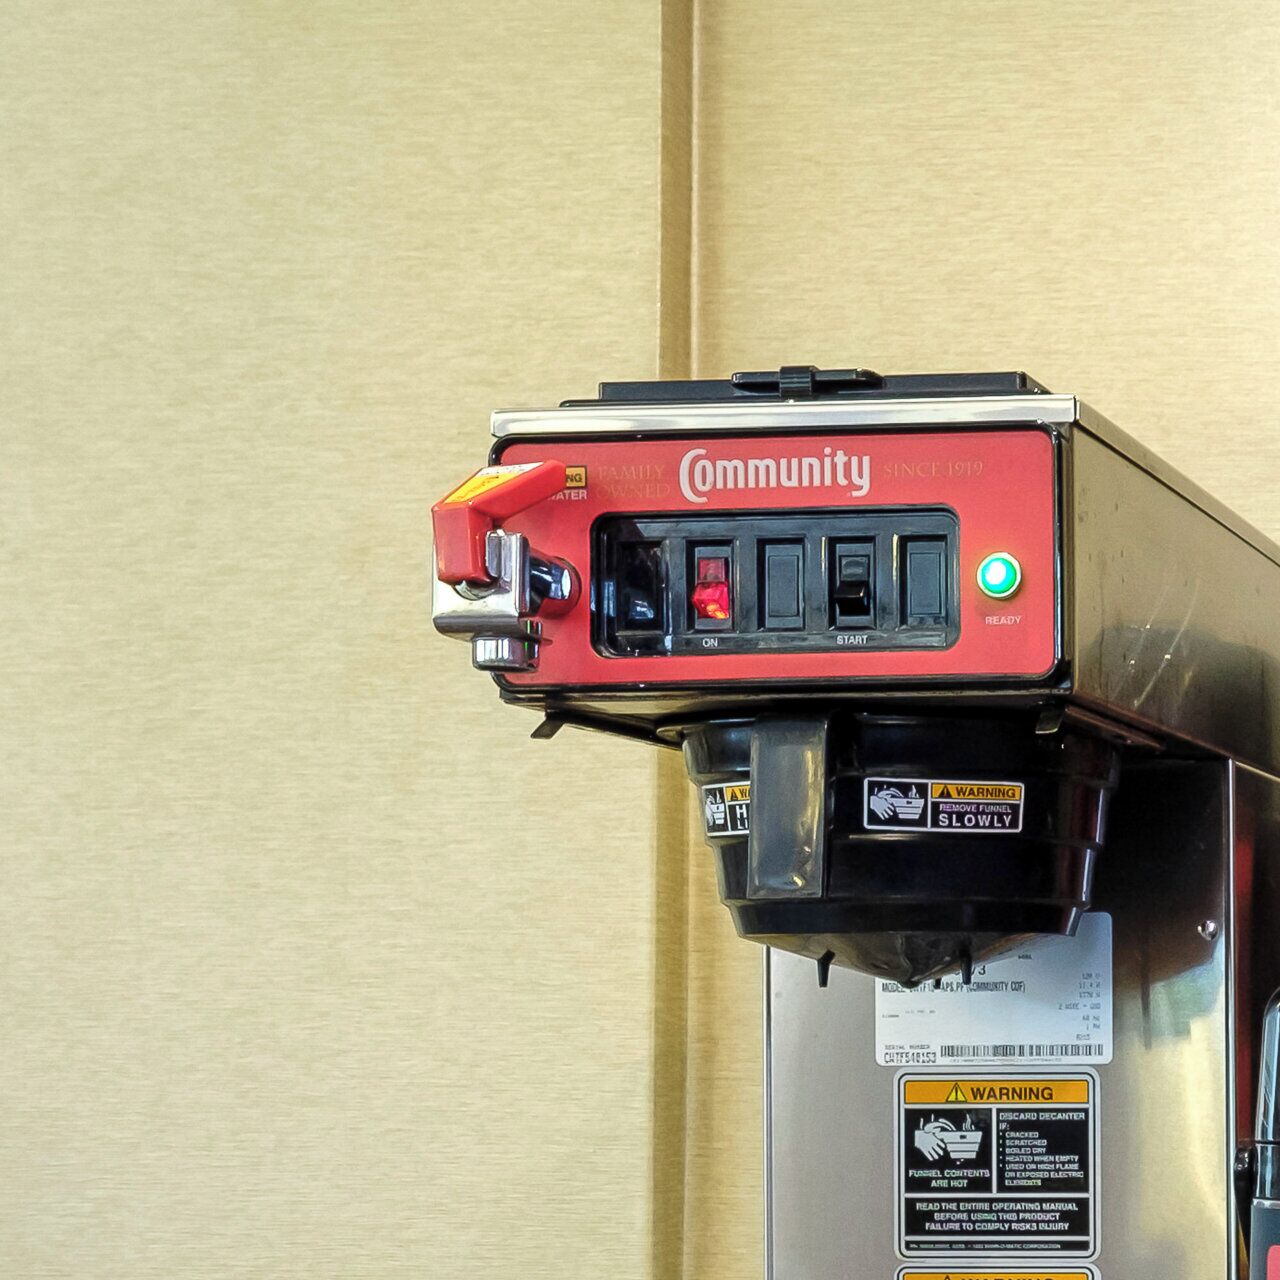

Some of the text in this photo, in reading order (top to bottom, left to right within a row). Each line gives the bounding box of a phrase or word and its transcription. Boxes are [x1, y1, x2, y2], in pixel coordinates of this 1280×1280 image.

[679, 447, 870, 503] Community
[985, 615, 1021, 625] READY
[703, 638, 718, 647] ON
[837, 635, 868, 645] START
[956, 787, 1016, 799] WARNING
[940, 804, 1011, 813] REMOVE FUNNEL
[939, 815, 1011, 827] SLOWLY
[971, 1087, 1053, 1100] WARNING
[931, 1180, 968, 1188] ARE HOT
[916, 1203, 1078, 1211] READ THE ENTIRE OPERATING MANUAL
[926, 1223, 1069, 1231] FAILURE TO COMPLY RISKS INJURY
